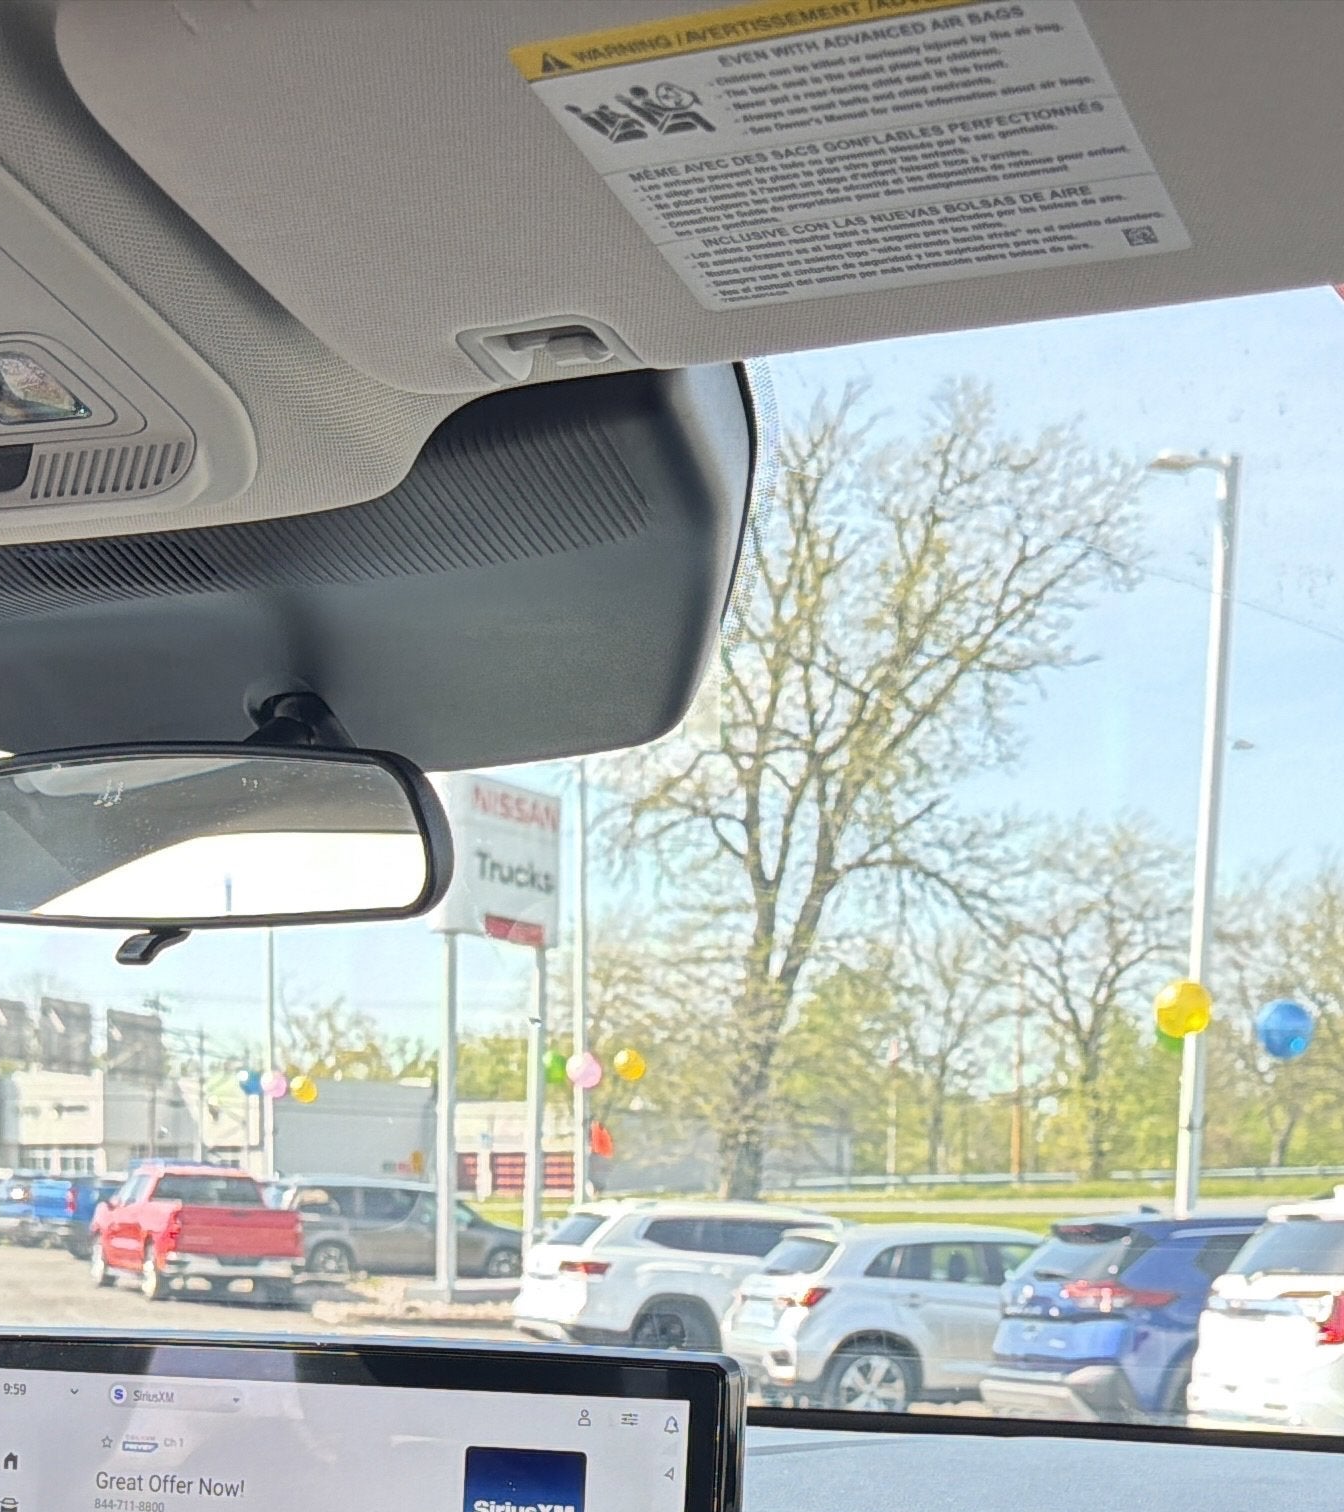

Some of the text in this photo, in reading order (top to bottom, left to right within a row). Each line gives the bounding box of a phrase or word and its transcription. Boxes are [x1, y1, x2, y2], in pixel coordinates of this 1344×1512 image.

[572, 35, 671, 63] WARNING
[718, 48, 767, 66] EVEN
[770, 39, 818, 58] WITH
[822, 21, 926, 49] ADVANCED
[930, 15, 962, 31] AIR
[967, 4, 1023, 25] BAGS
[681, 157, 728, 174] AVEC
[731, 151, 767, 166] DES
[770, 143, 819, 160] SACS
[822, 124, 943, 153] GONFLABLES
[947, 99, 1104, 134] PERFECTIONNÉS
[702, 185, 1091, 247] INCLUSIVE CON LAS NUEVAS BOLSAS DE AIRE
[474, 784, 559, 832] NISSAN
[475, 850, 555, 895] Trucks
[3, 1383, 27, 1396] 9:59
[133, 1389, 175, 1403] SiriusXM
[163, 1437, 177, 1448] Ch
[95, 1471, 245, 1498] Great Offer Now!
